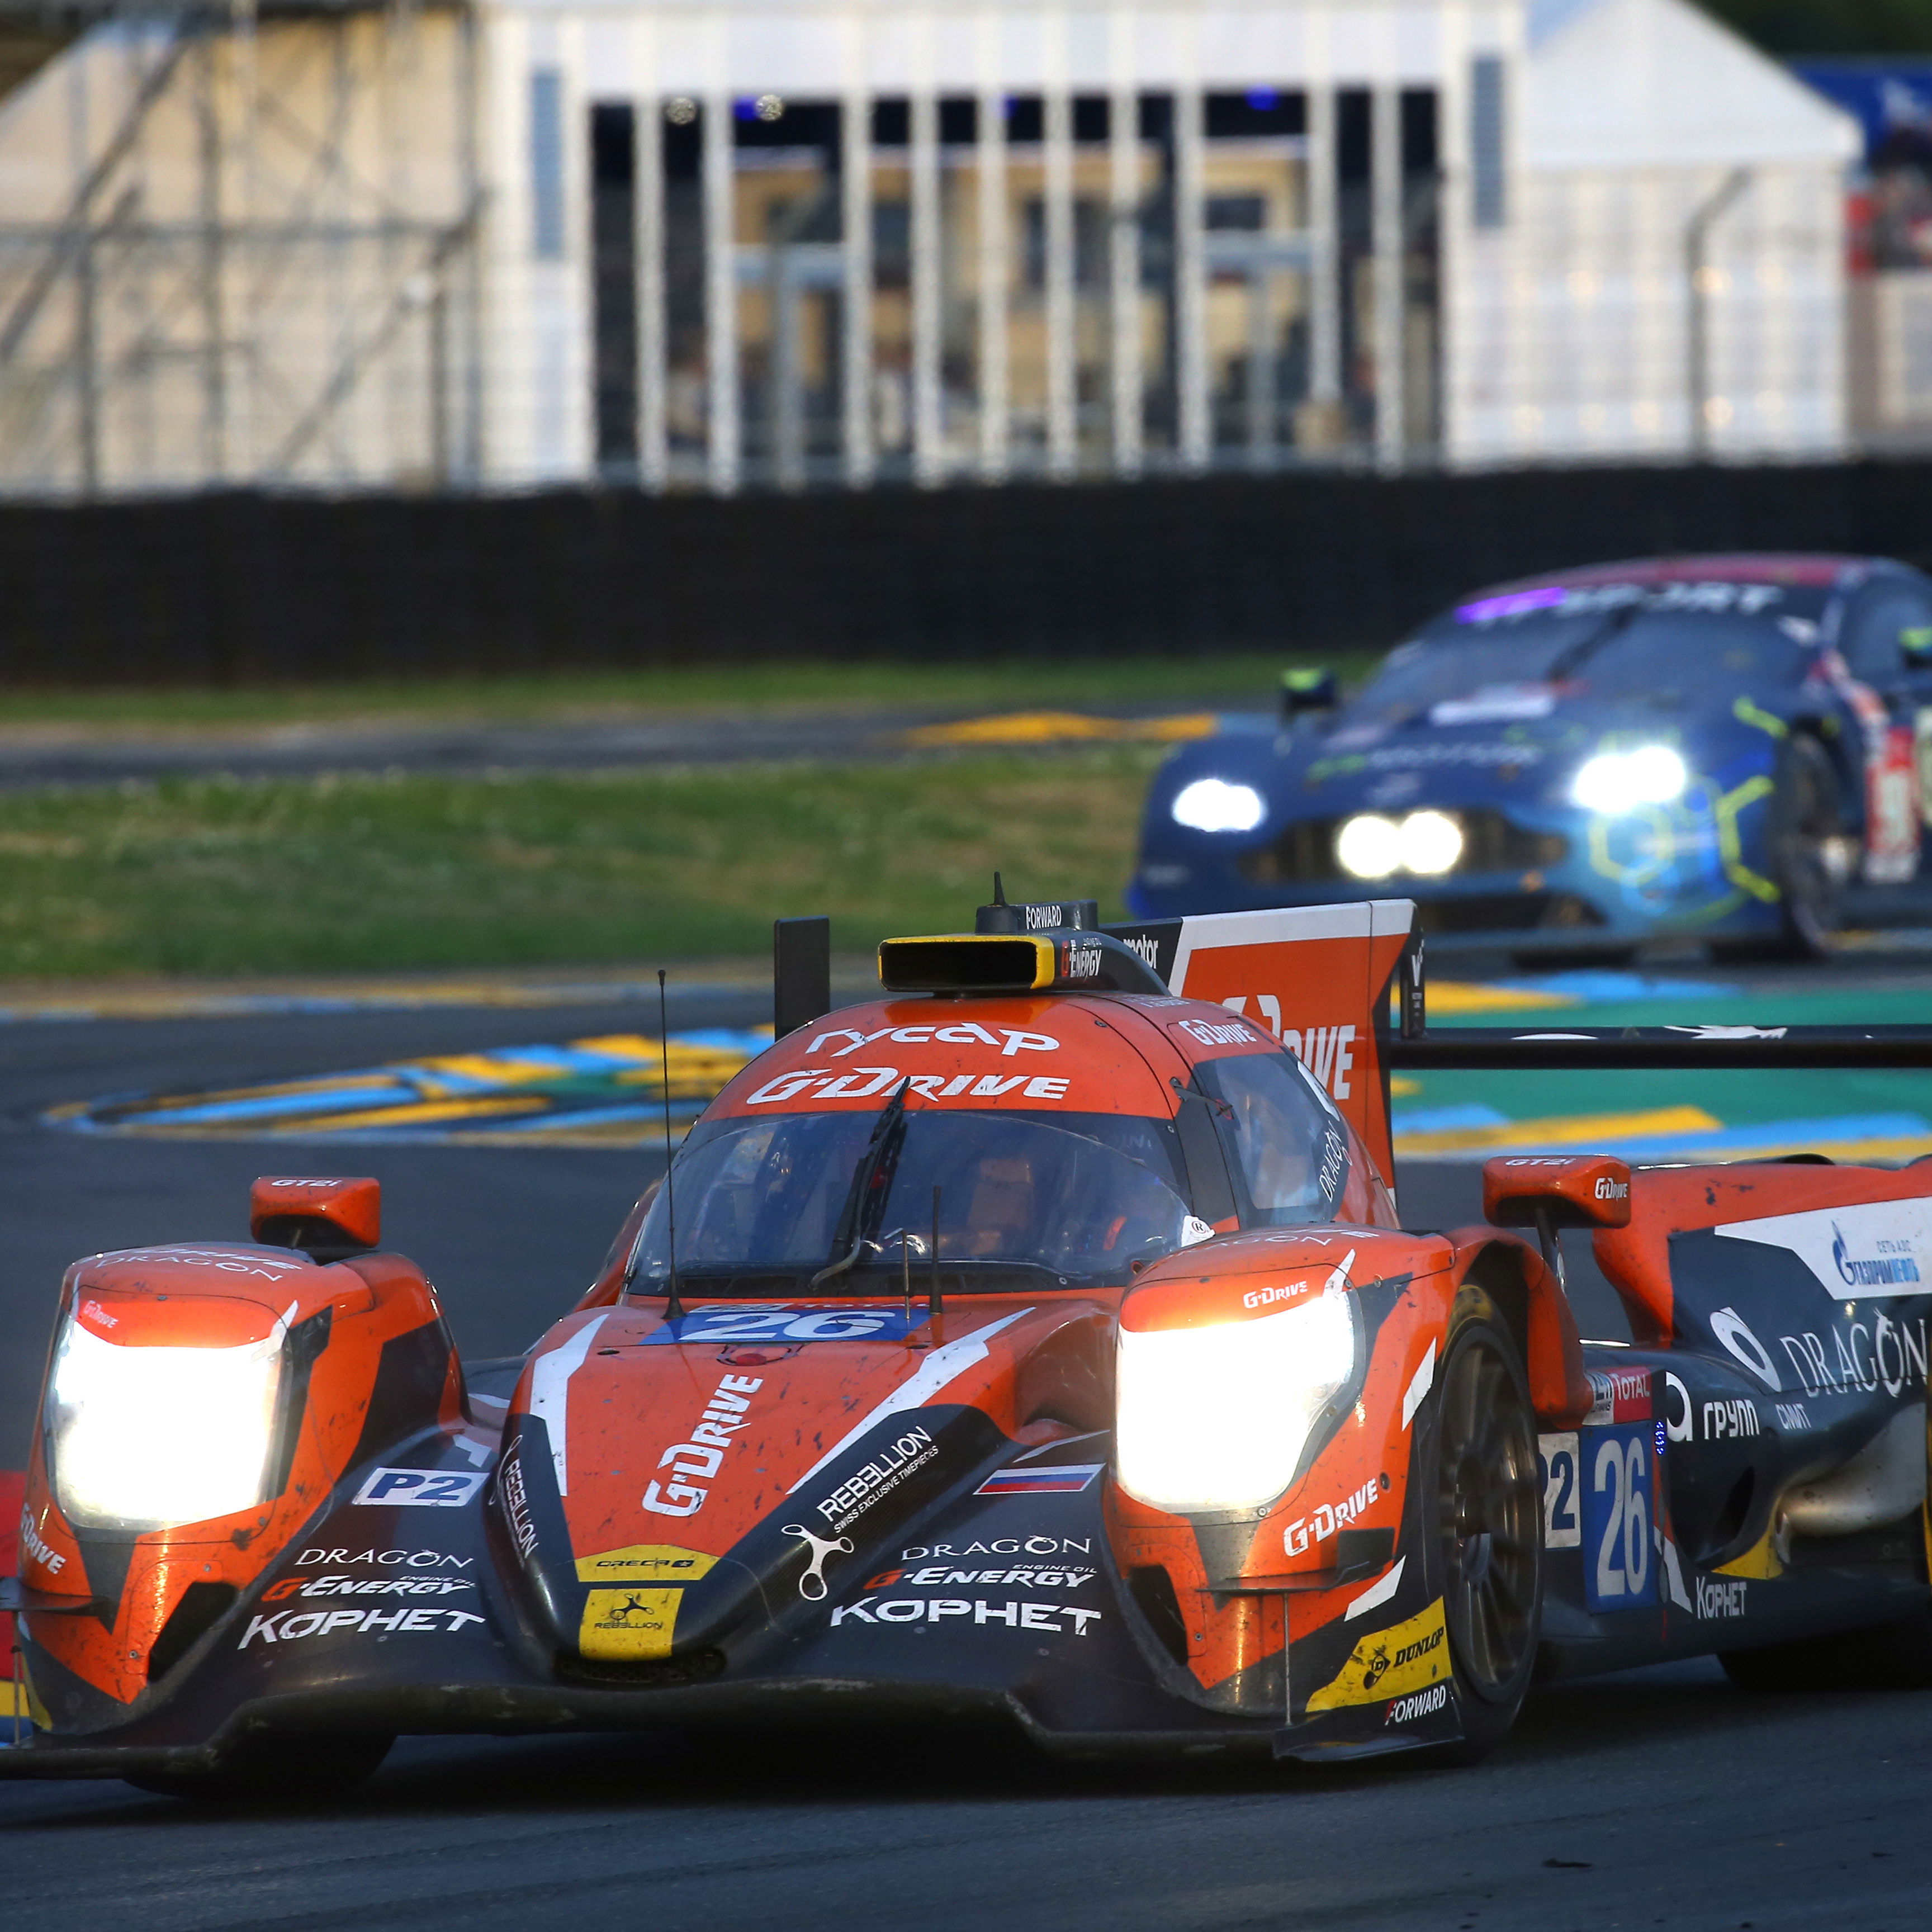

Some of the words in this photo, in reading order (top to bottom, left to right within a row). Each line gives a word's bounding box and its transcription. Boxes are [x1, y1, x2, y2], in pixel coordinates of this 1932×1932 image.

[1026, 905, 1062, 929] FORWARD
[95, 1256, 283, 1281] DRAGON
[679, 1311, 895, 1340] 26
[1779, 1311, 1928, 1398] DRAGON
[1609, 1372, 1650, 1400] TOTAL
[367, 1473, 471, 1500] P2
[817, 1426, 932, 1522] REBELLION
[834, 1509, 860, 1533] SWISS
[858, 1476, 900, 1513] EXCLUSIVE
[898, 1445, 939, 1480] TIMEPIECES
[1594, 1437, 1647, 1597] 26
[294, 1549, 474, 1569] DRAGON
[901, 1535, 1091, 1561] DRAGON
[453, 1578, 476, 1587] OIL
[1393, 1626, 1445, 1668] DUNLOP
[1384, 1685, 1446, 1726] FORWARD
